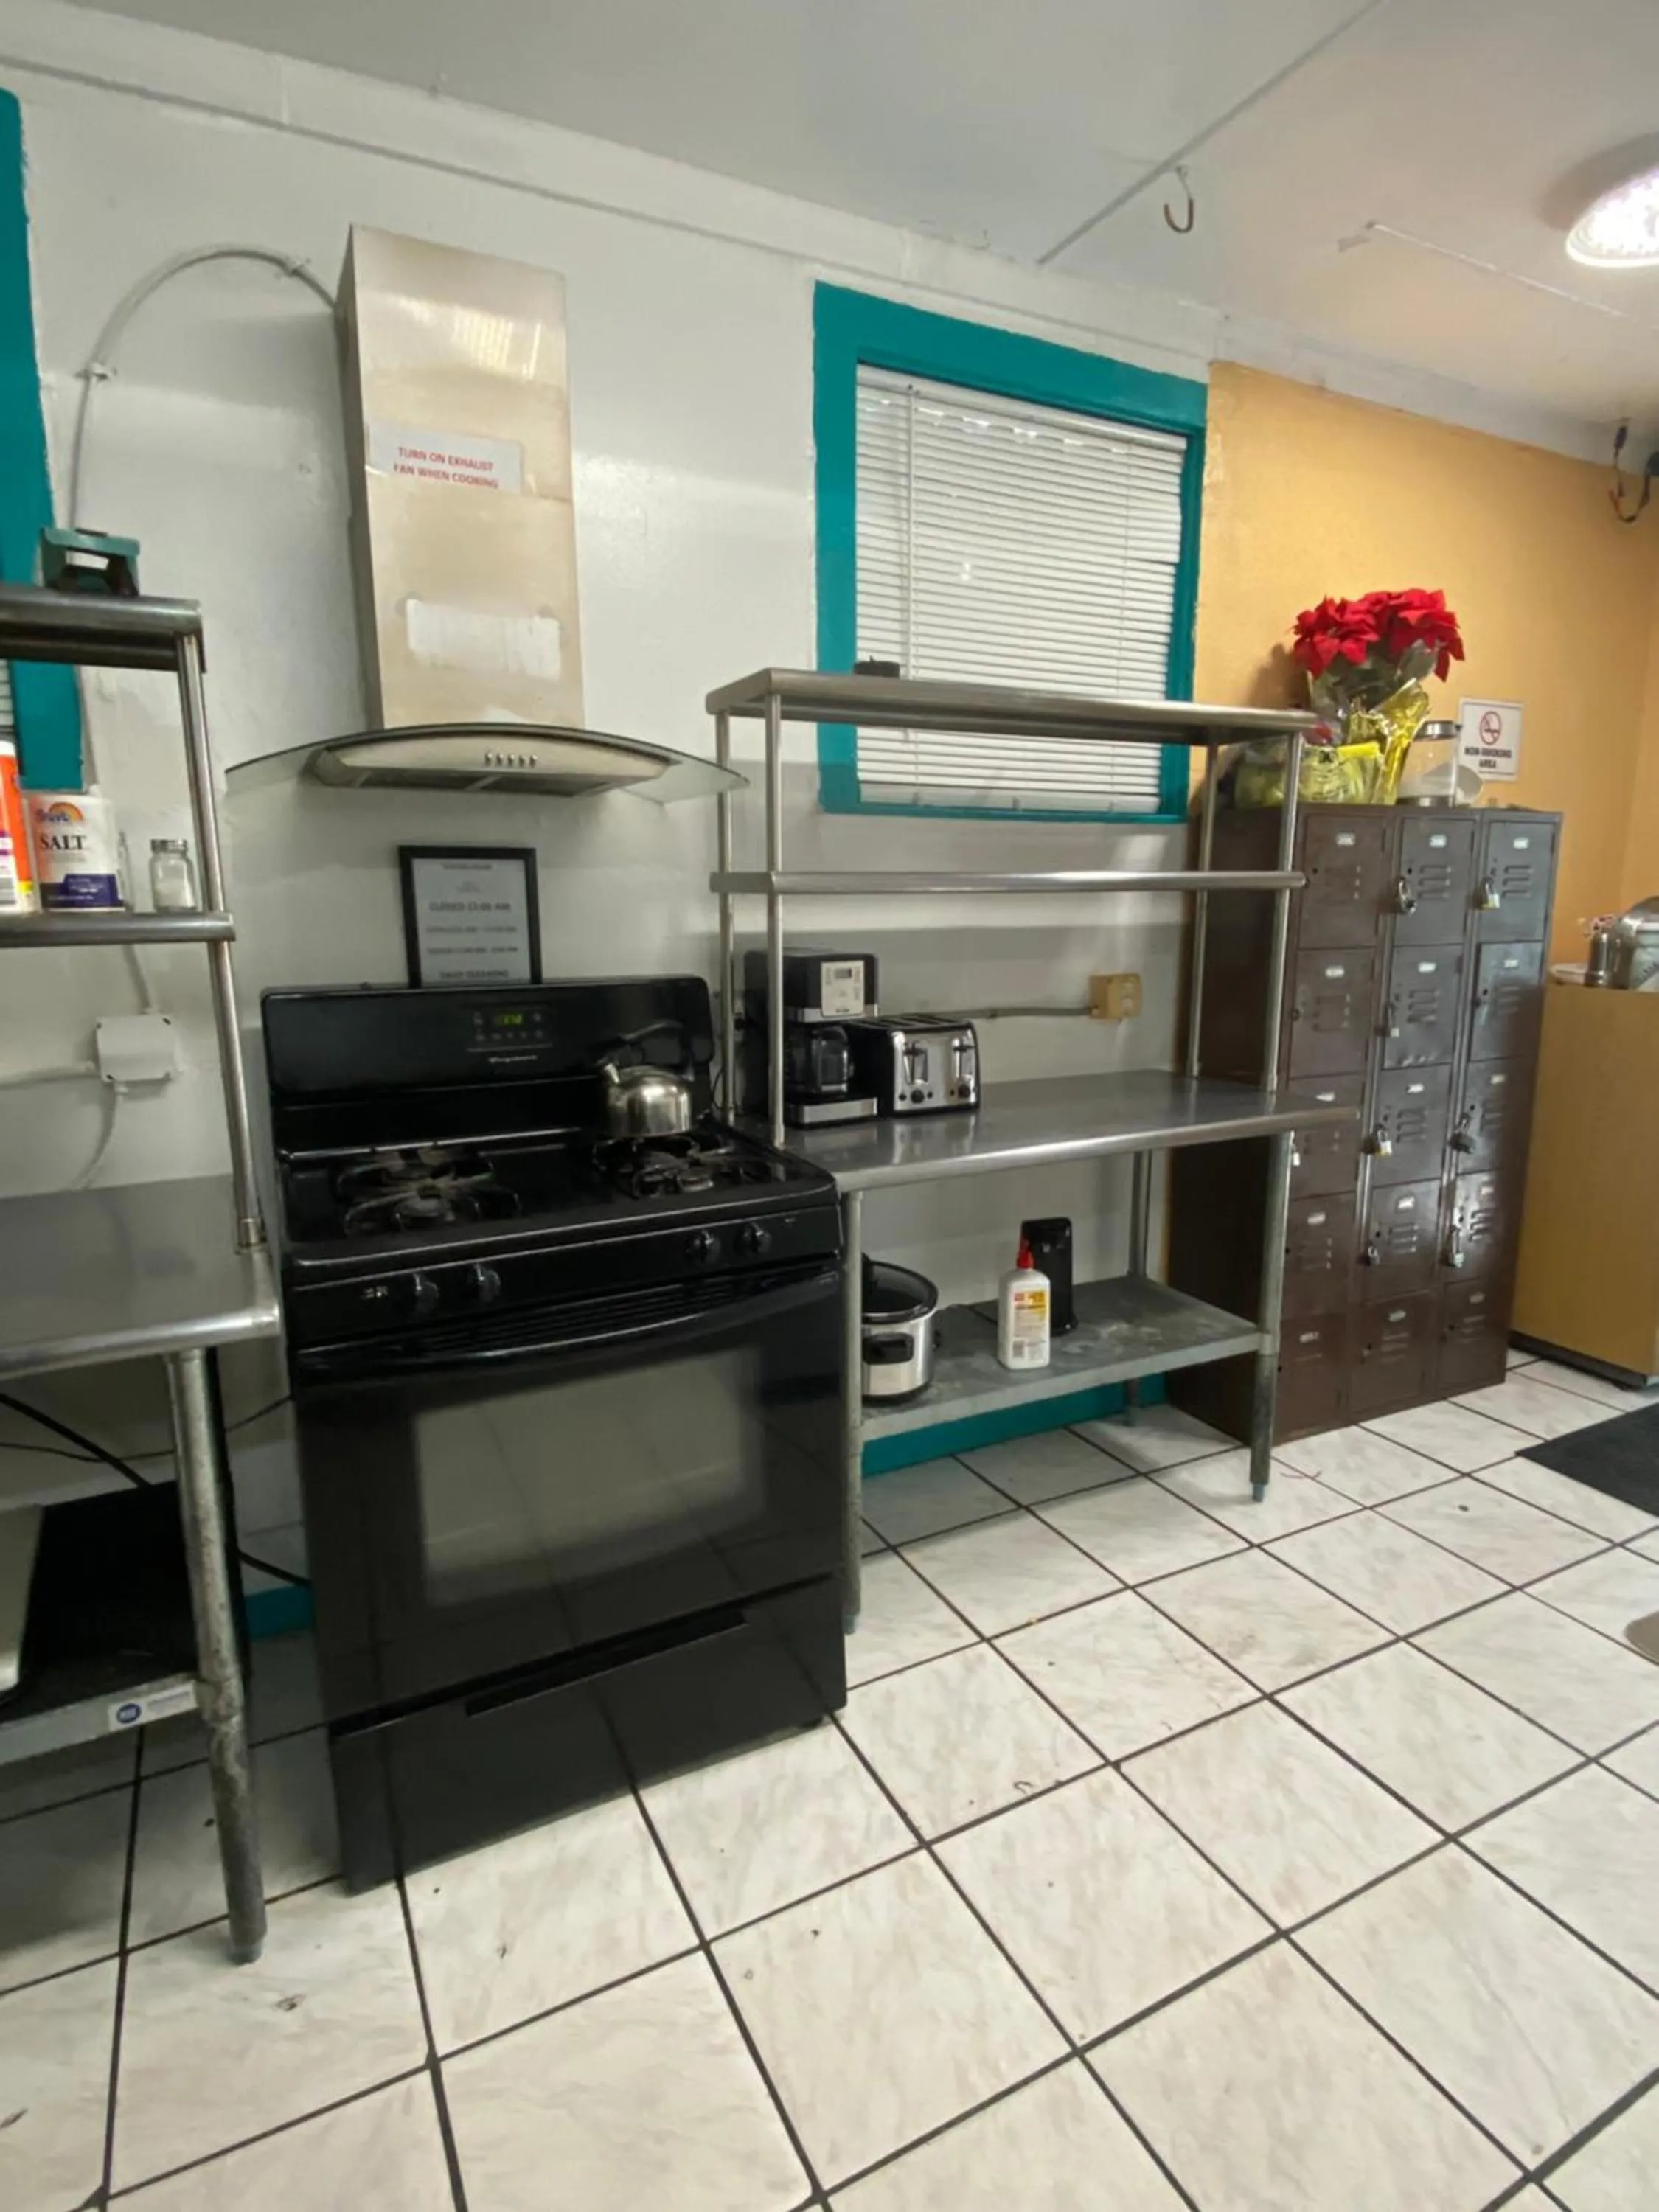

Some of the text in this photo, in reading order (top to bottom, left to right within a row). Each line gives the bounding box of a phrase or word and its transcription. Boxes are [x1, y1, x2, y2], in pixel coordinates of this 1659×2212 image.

[398, 446, 493, 472] TURN ON EXHAUST
[394, 463, 498, 490] FAN WHEN COOKING
[39, 835, 87, 851] SALT
